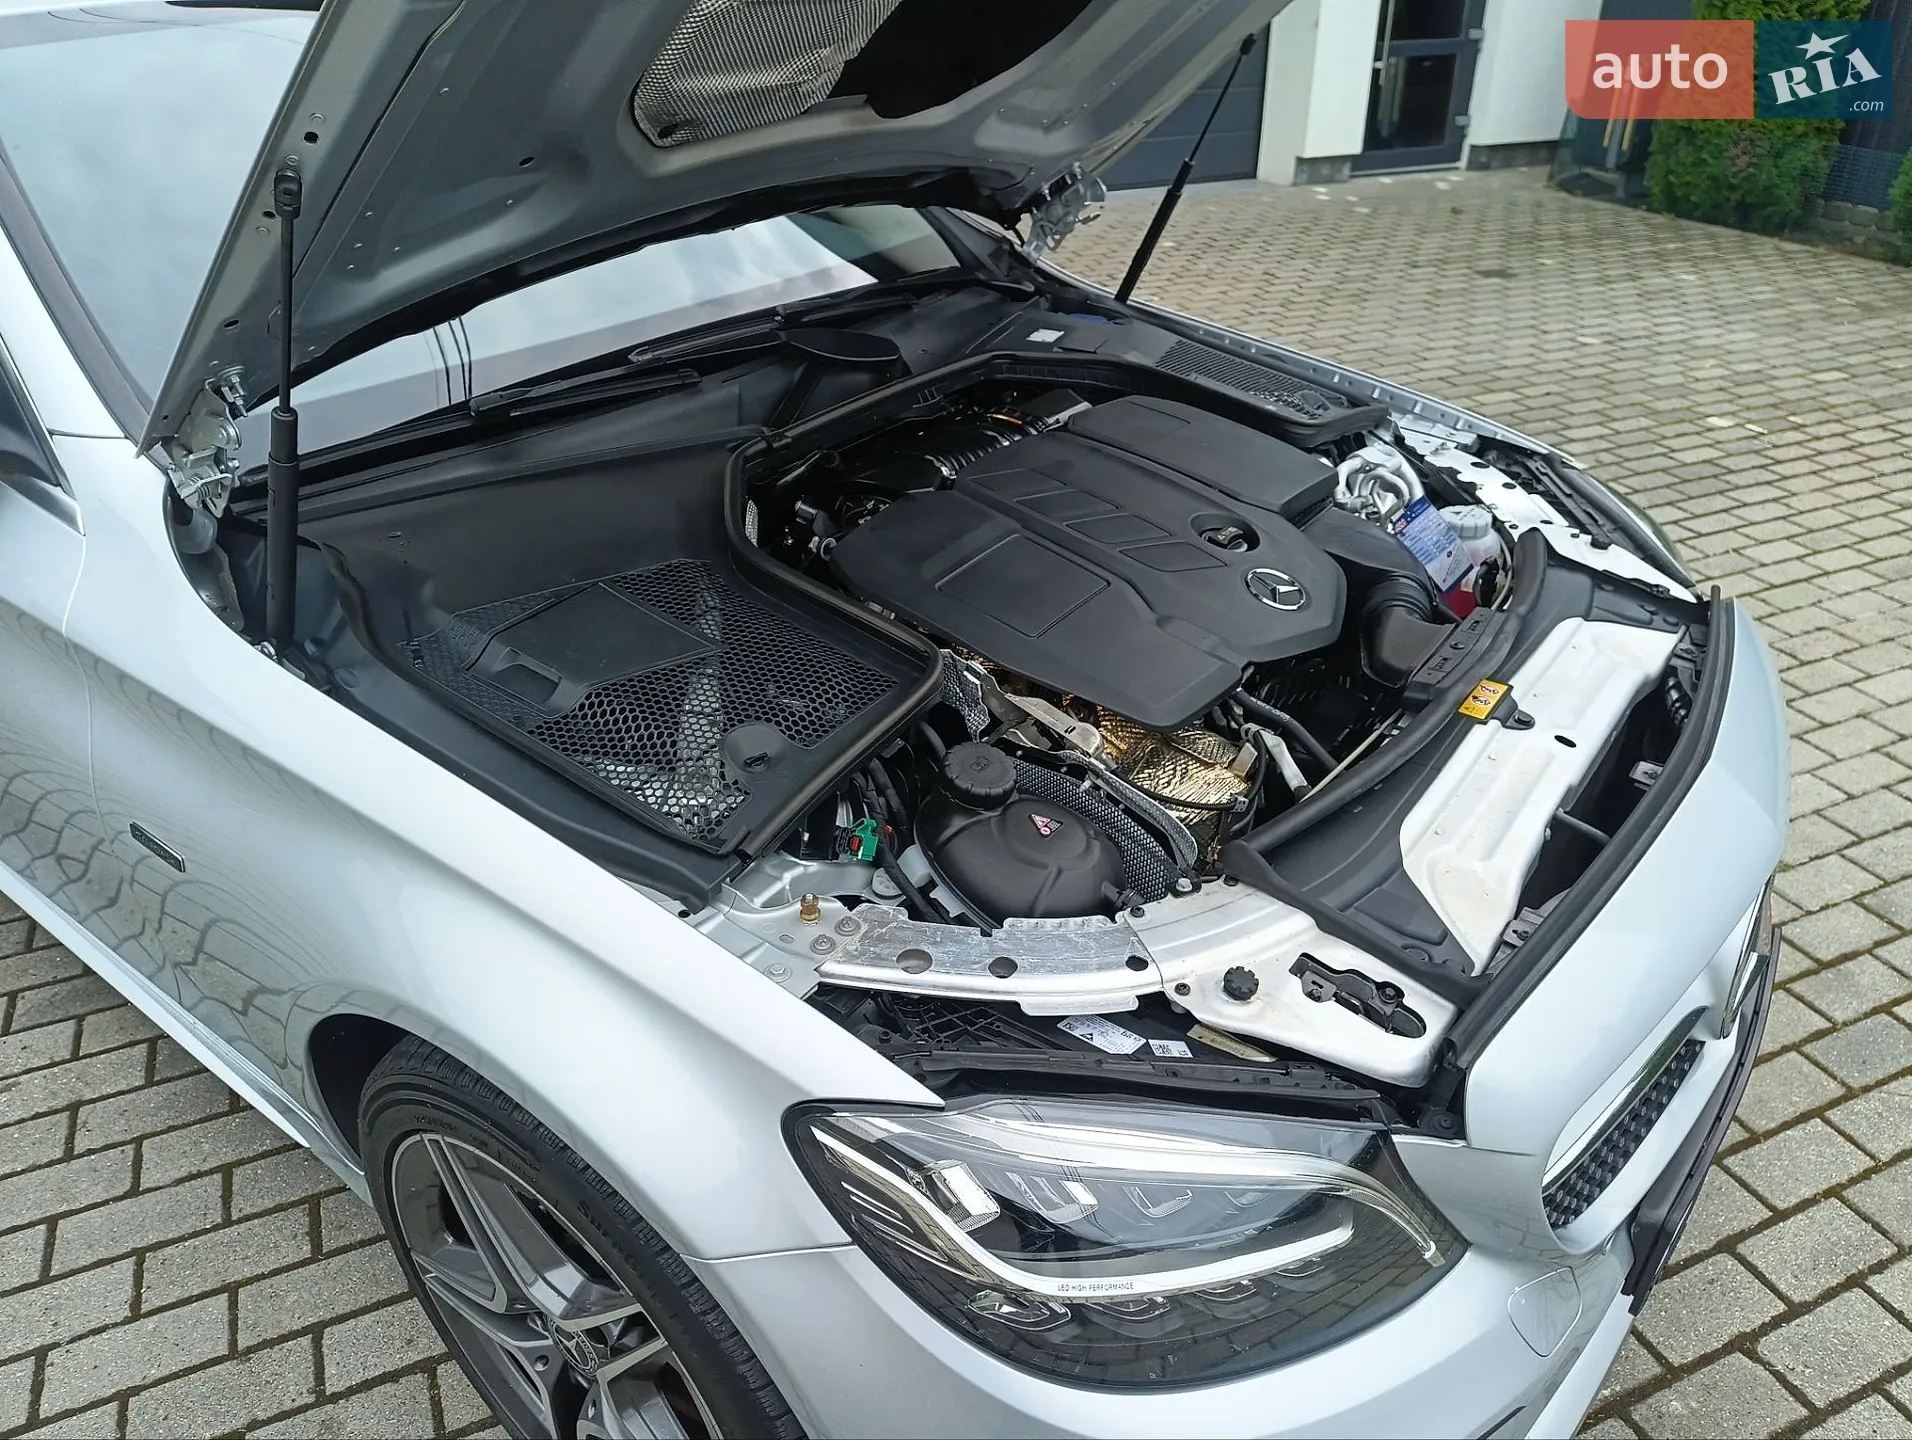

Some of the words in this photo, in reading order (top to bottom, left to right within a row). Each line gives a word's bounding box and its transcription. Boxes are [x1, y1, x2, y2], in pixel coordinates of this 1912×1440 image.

[1057, 1284, 1070, 1292] LED
[1071, 1283, 1087, 1292] HIGH
[1088, 1281, 1134, 1292] PERFORMANCE
